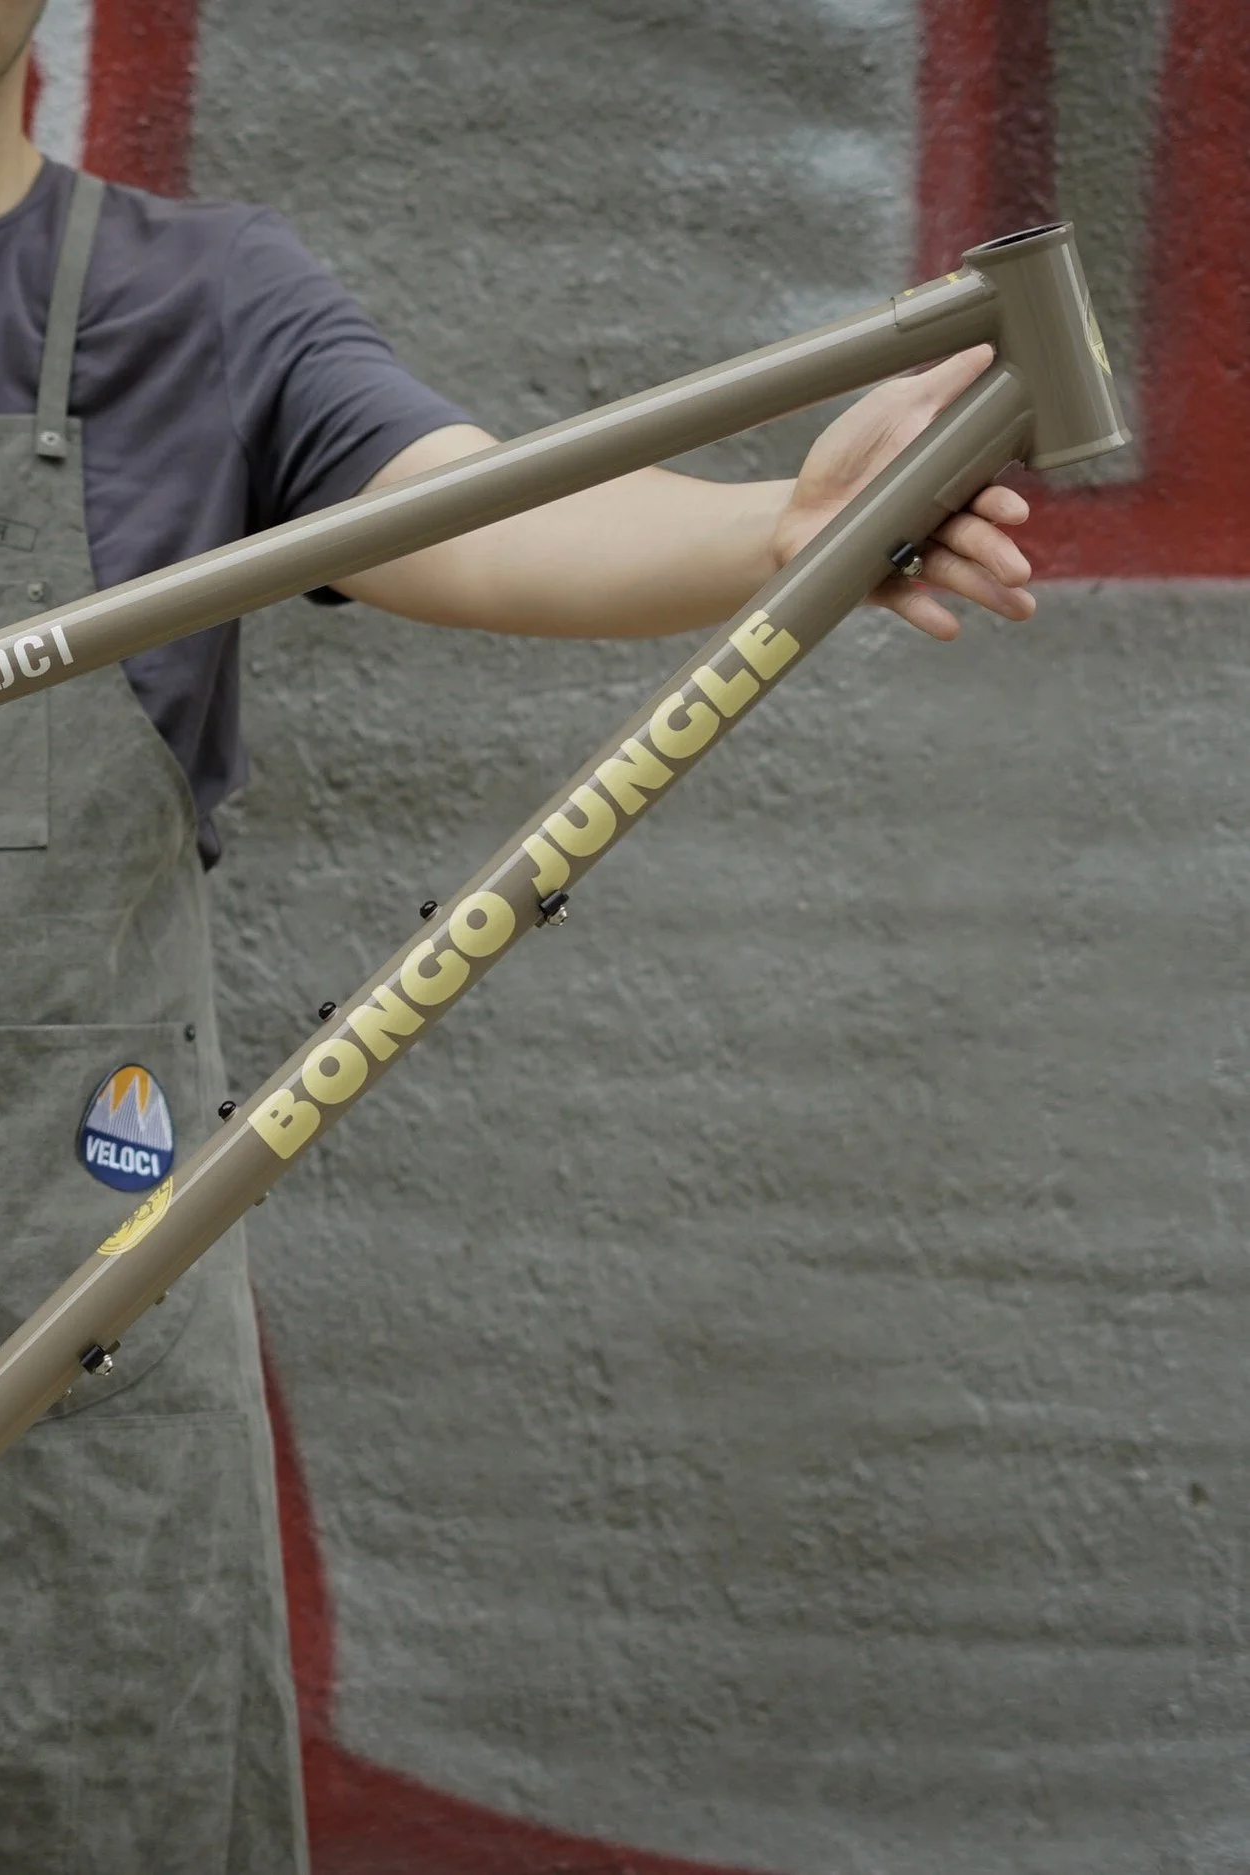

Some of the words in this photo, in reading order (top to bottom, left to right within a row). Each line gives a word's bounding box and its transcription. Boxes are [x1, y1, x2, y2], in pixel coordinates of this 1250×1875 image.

[247, 891, 516, 1160] BONGO
[521, 609, 800, 899] JUNGLE
[85, 1134, 161, 1178] VELOCI
